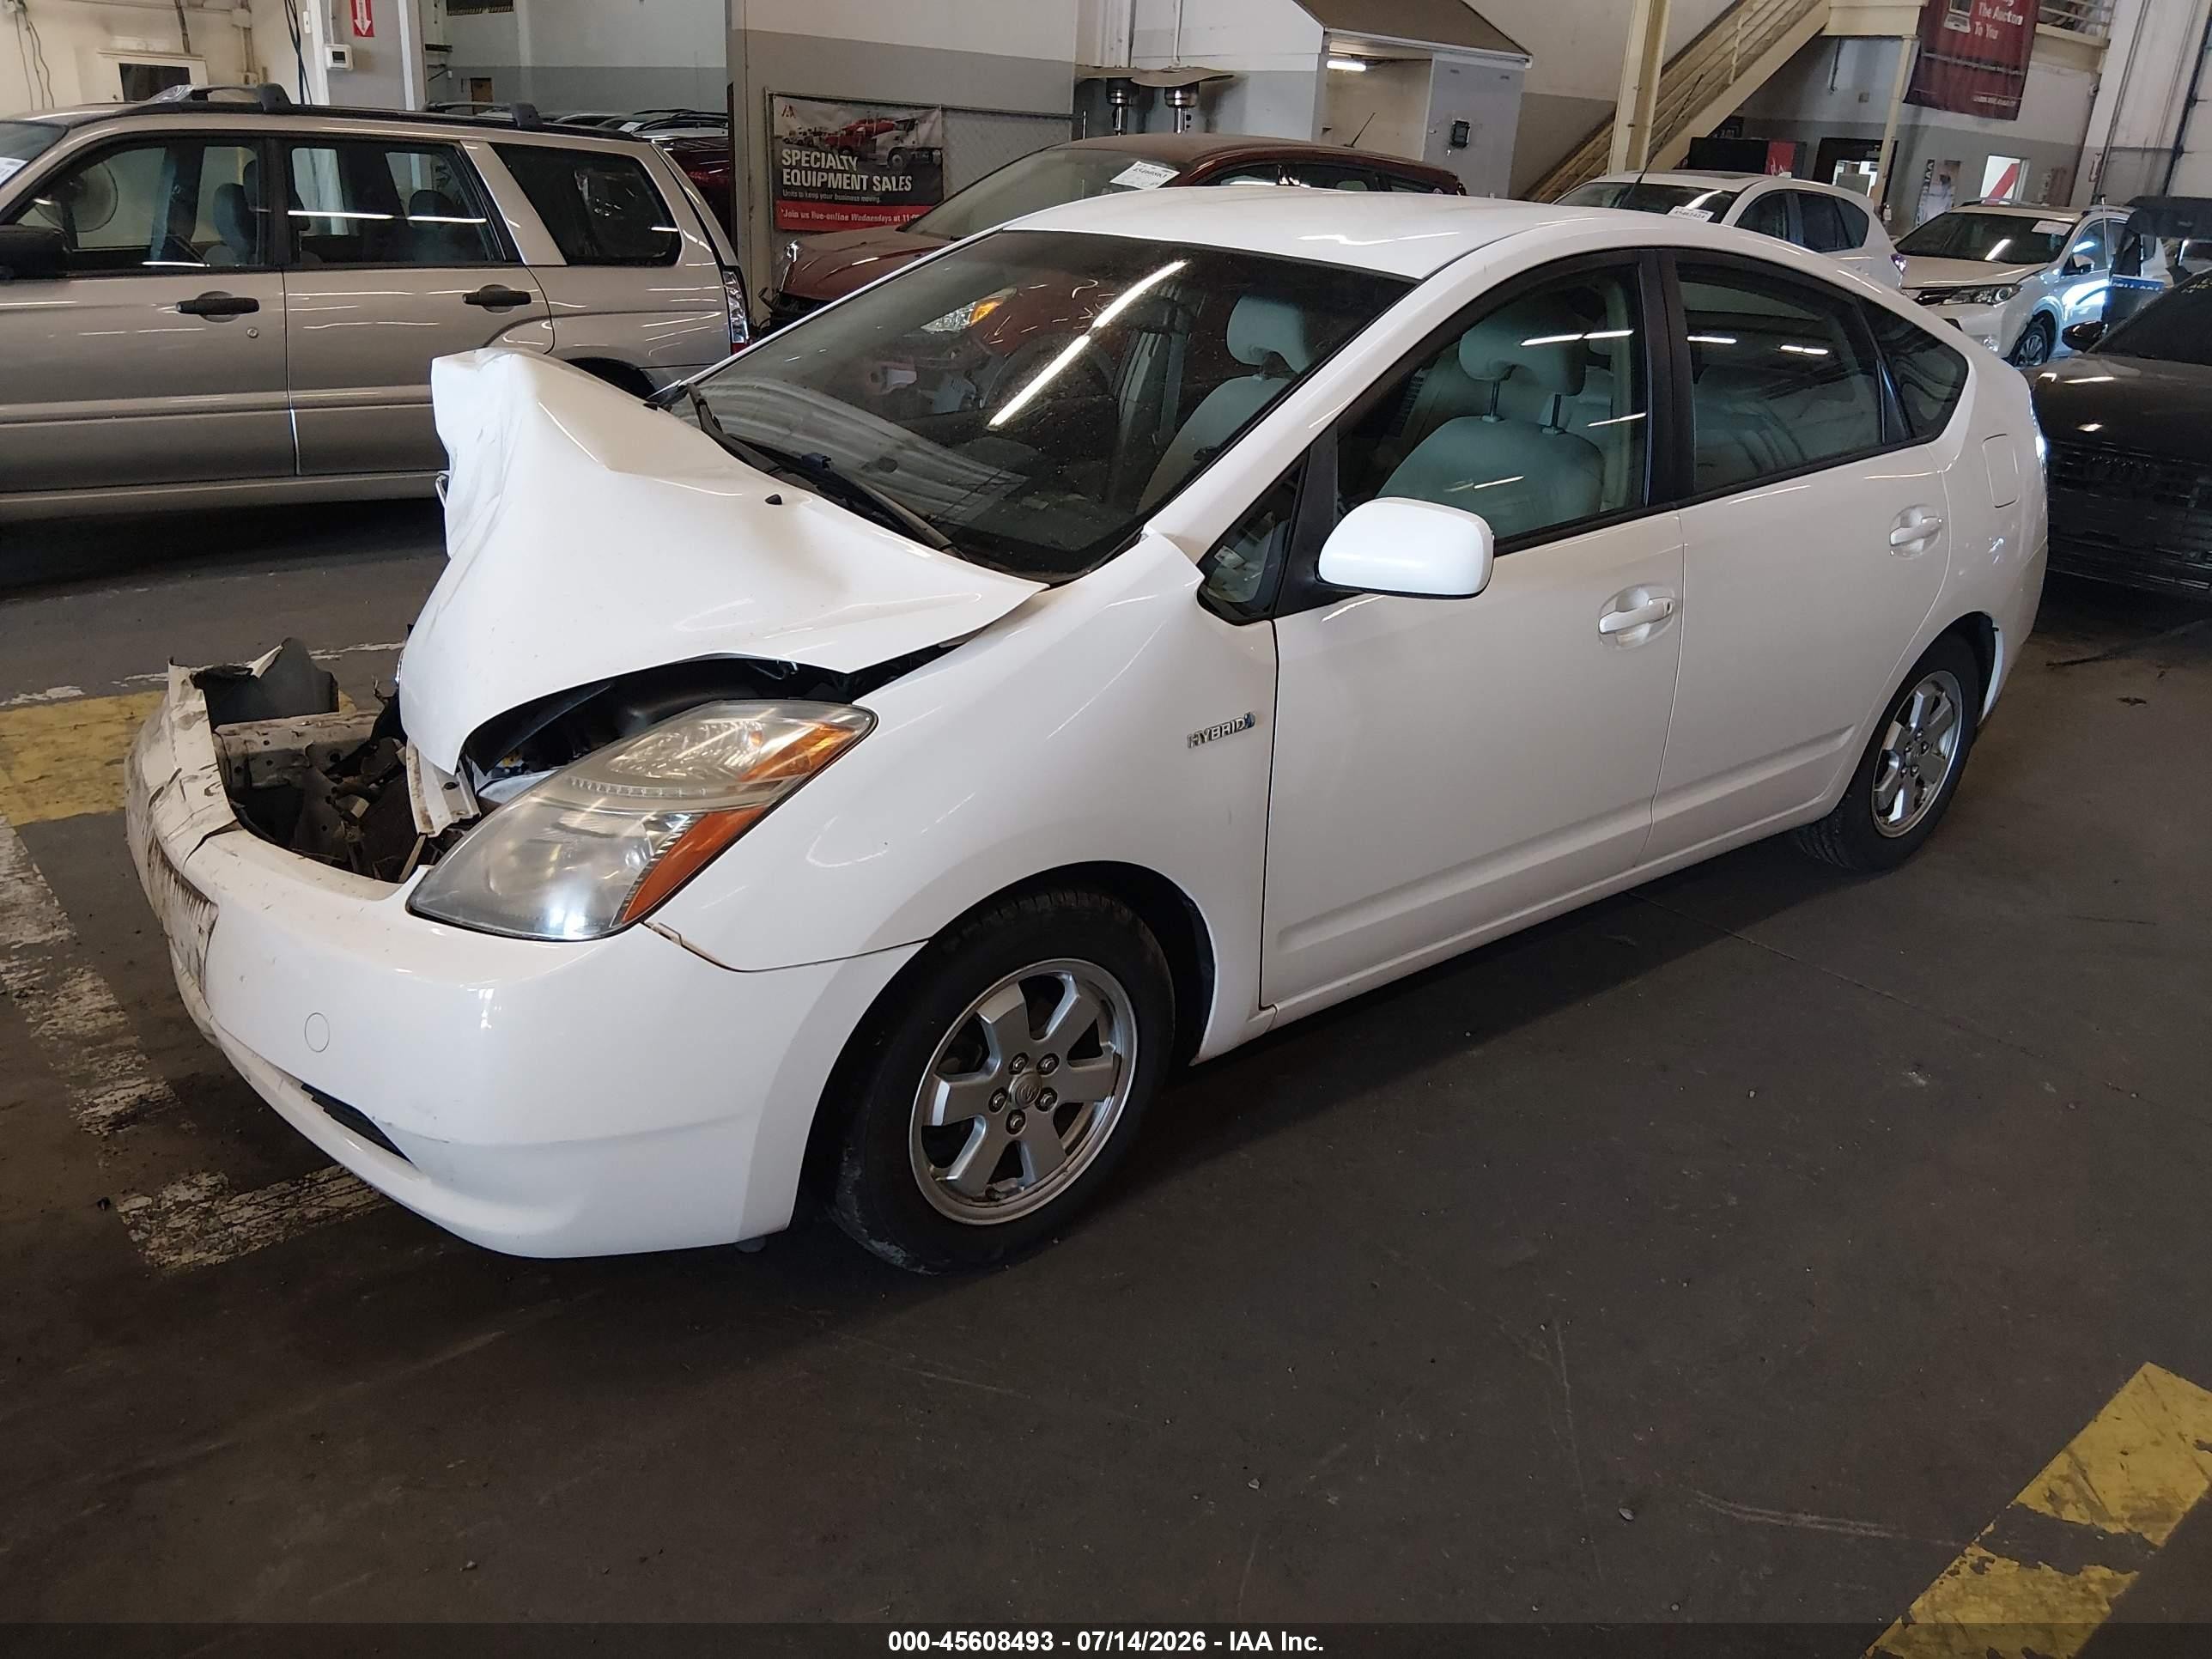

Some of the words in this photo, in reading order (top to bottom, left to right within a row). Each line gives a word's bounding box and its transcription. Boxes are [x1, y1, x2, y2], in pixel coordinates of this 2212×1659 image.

[1978, 2, 1992, 18] The
[1974, 21, 1984, 36] To
[1985, 23, 1999, 40] You
[781, 149, 859, 171] SPECIALTY
[782, 168, 868, 191] EQUIPMENT
[872, 175, 913, 191] SALES
[783, 188, 797, 198] Units
[783, 209, 799, 218] Join
[811, 210, 849, 221] live-online
[851, 213, 892, 224] Wednesdays
[1188, 718, 1245, 748] HYBRID
